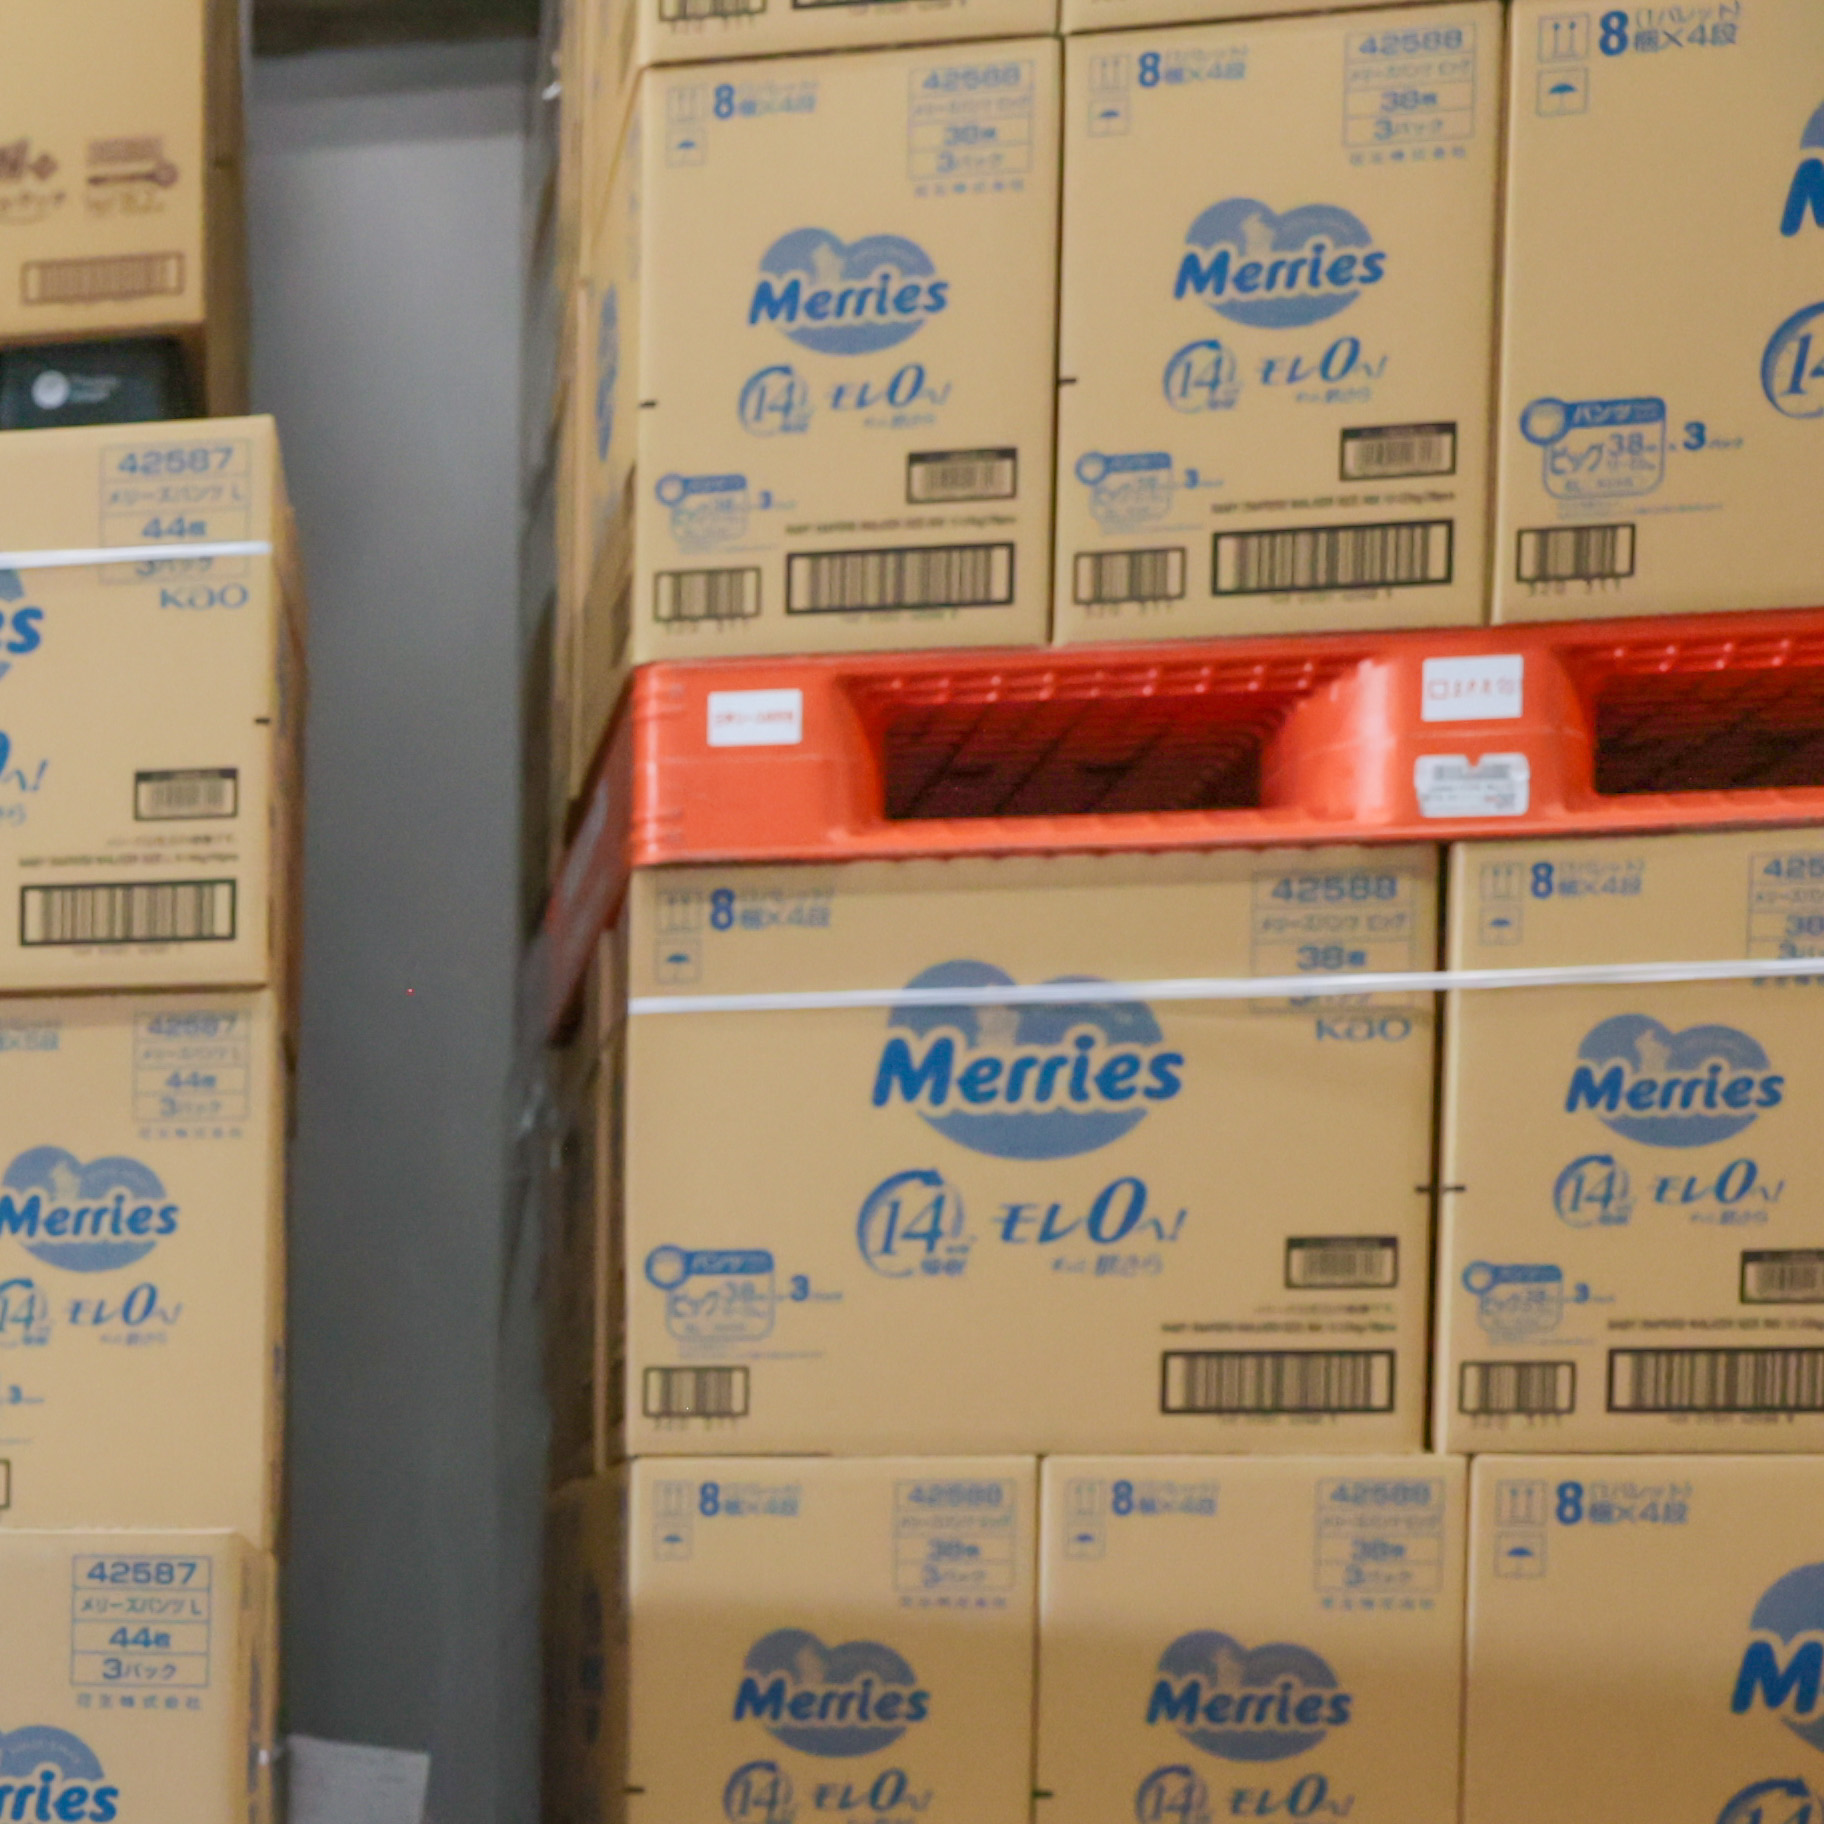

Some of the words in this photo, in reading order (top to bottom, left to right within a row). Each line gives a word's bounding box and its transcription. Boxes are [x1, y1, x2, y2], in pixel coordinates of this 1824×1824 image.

[1599, 10, 1628, 55] 8
[1175, 244, 1387, 300] Merries
[748, 274, 949, 325] Merries
[117, 447, 235, 476] 42587
[1530, 863, 1554, 898] 8
[709, 887, 736, 931] 8
[873, 1035, 1185, 1107] Merries
[1565, 1066, 1785, 1115] Merries
[1555, 1484, 1582, 1525] 8
[87, 1560, 198, 1586] 42587
[109, 1626, 172, 1651] 44枚
[101, 1658, 177, 1682] 3パック
[733, 1676, 930, 1726] Merries
[1147, 1679, 1353, 1730] Merries
